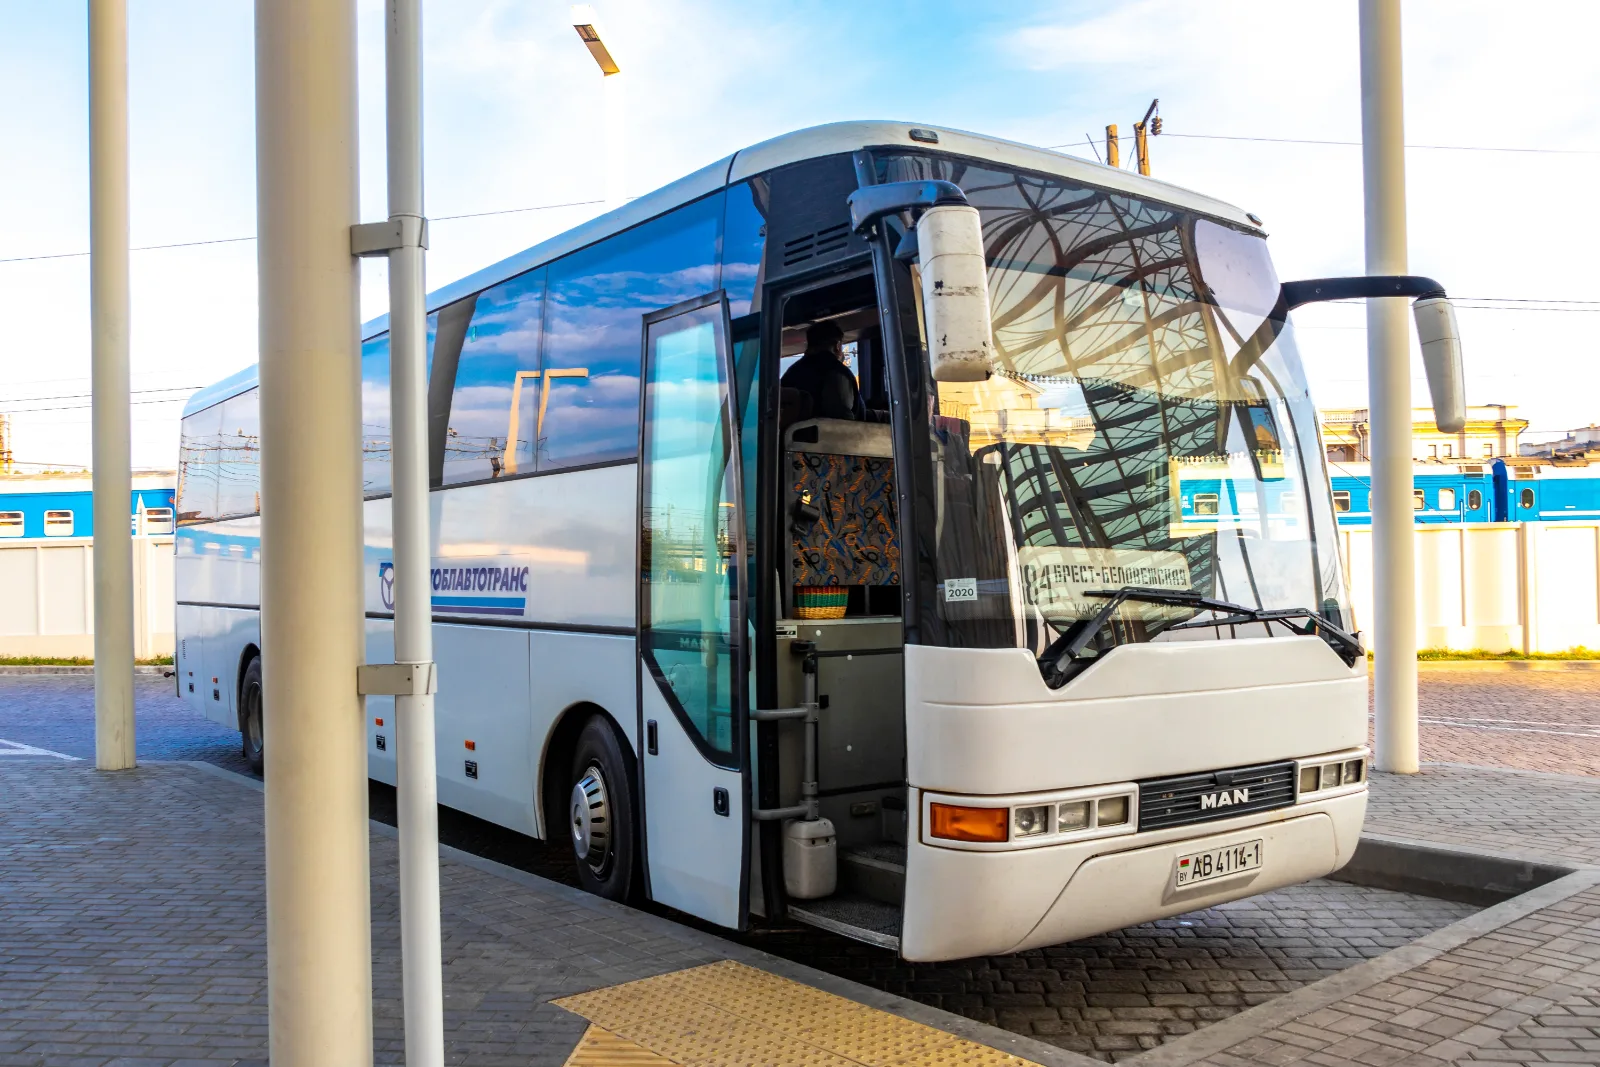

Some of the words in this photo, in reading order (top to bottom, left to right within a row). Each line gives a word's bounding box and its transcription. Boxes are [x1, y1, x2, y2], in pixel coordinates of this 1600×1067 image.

[948, 588, 974, 598] 2020
[1201, 788, 1249, 810] MAN
[1191, 854, 1213, 880] AB
[1216, 843, 1259, 873] 4114-1
[1179, 871, 1188, 882] BY
